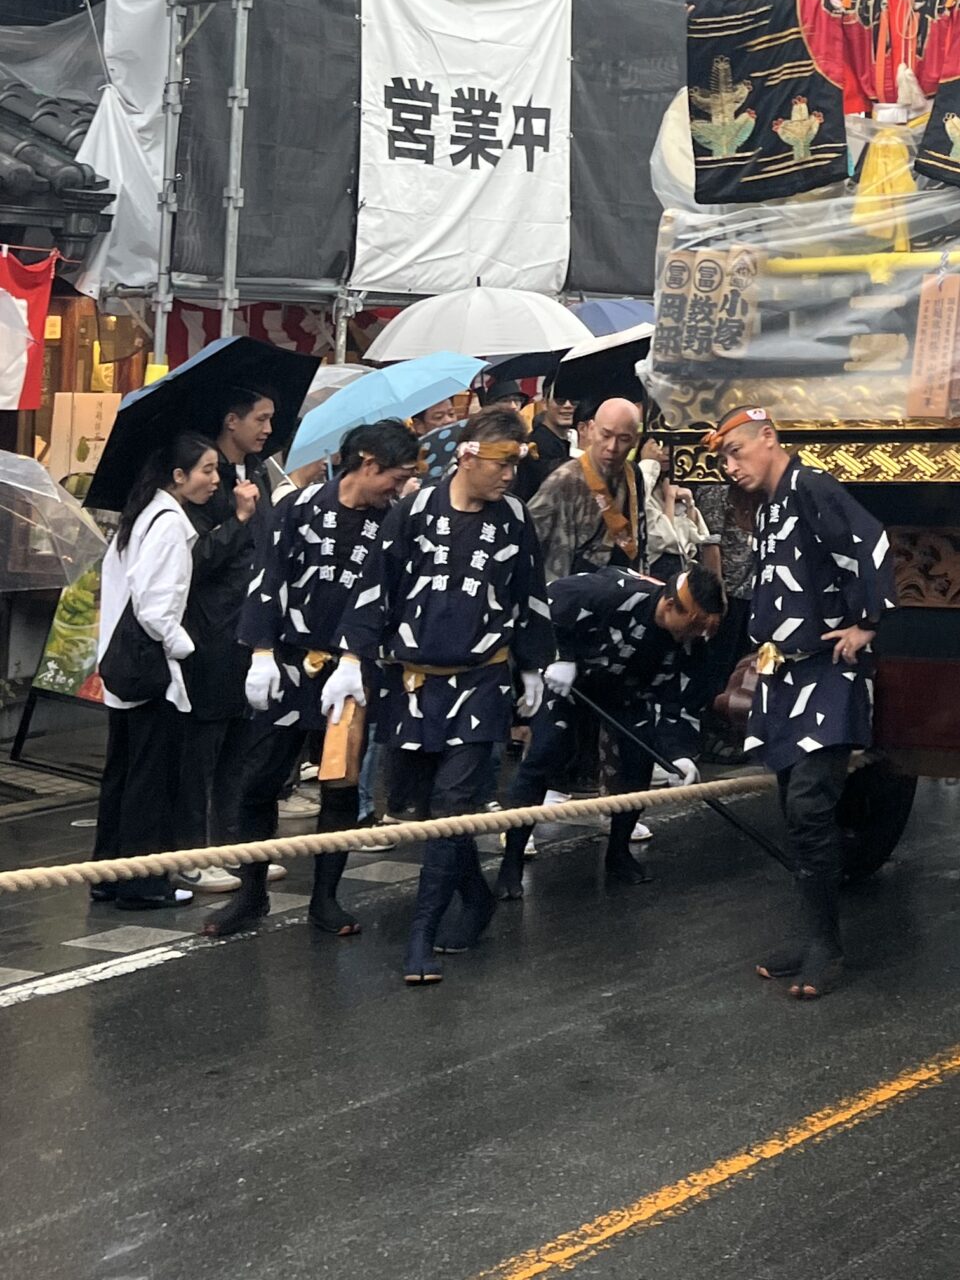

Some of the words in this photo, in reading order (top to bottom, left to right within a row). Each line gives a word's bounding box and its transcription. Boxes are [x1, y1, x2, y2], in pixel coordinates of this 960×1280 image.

[383, 76, 552, 172] 営業中
[713, 289, 749, 351] 小塚
[339, 519, 380, 589] 連雀町
[461, 522, 497, 597] 連雀町
